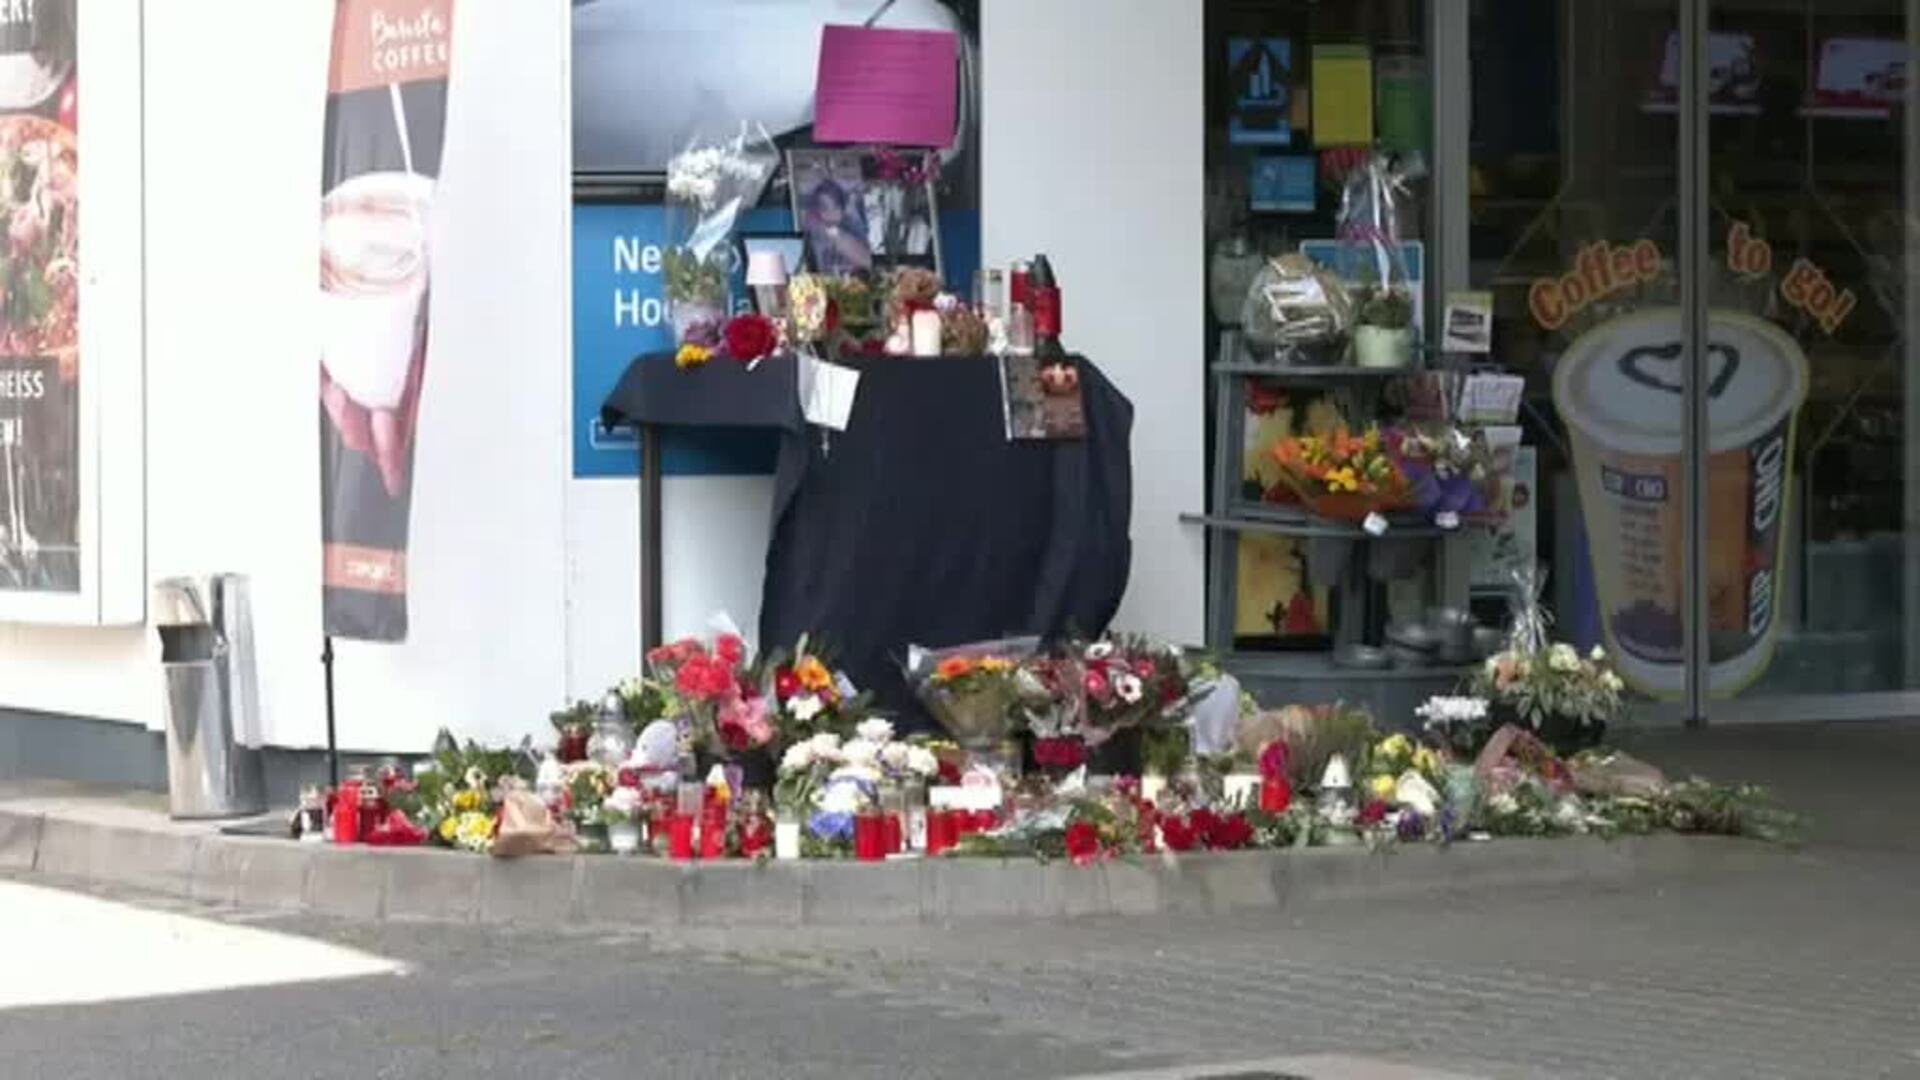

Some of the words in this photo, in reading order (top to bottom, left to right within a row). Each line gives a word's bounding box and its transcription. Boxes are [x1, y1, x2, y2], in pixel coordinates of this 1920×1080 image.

[1530, 239, 1657, 329] Coffee
[1728, 222, 1771, 273] to
[1781, 258, 1855, 334] go!
